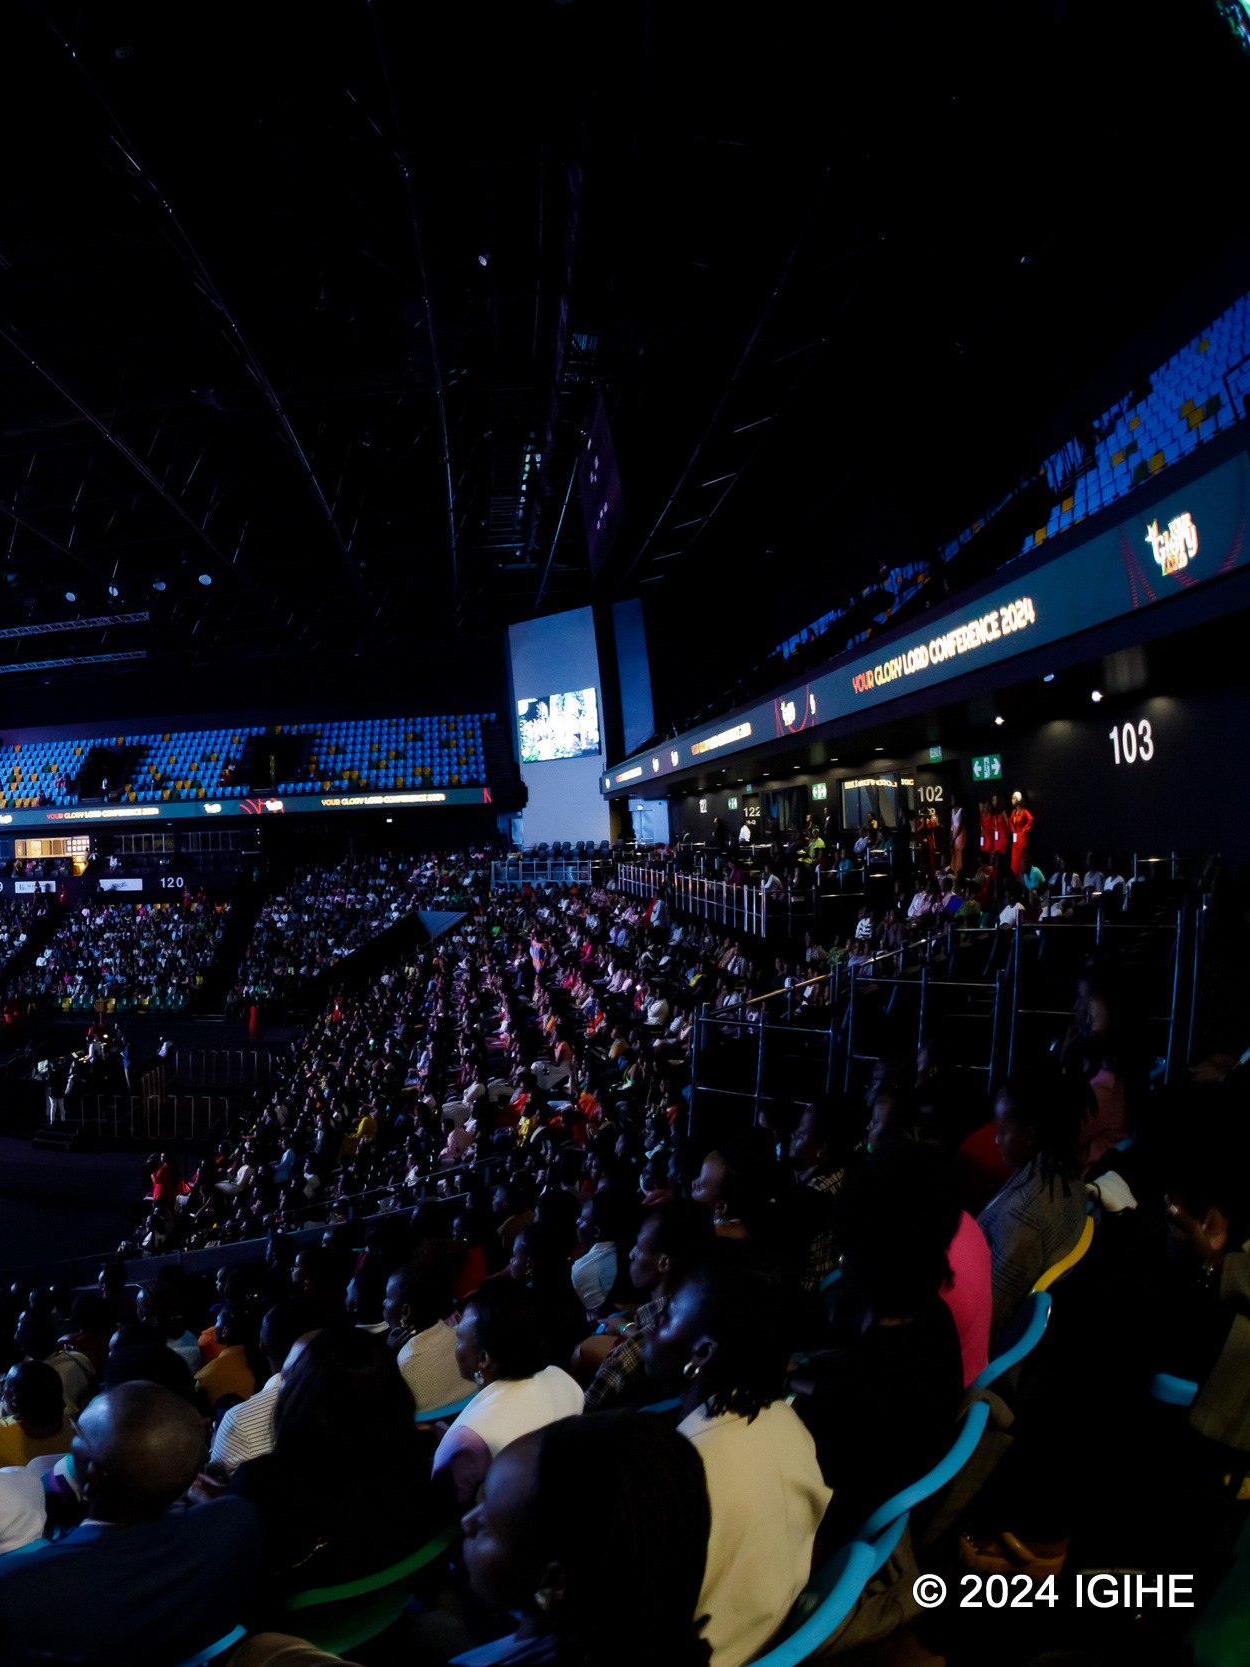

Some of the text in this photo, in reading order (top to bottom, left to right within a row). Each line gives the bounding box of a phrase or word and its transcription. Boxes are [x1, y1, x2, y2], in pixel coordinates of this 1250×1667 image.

[852, 596, 1036, 694] YOUR GLORY LORD CONFERENCE 2024
[1109, 719, 1154, 764] 103
[917, 785, 943, 802] 102
[341, 797, 364, 805] GLORY
[63, 811, 85, 819] GLORY
[743, 806, 761, 817] 122
[160, 877, 184, 888] 120
